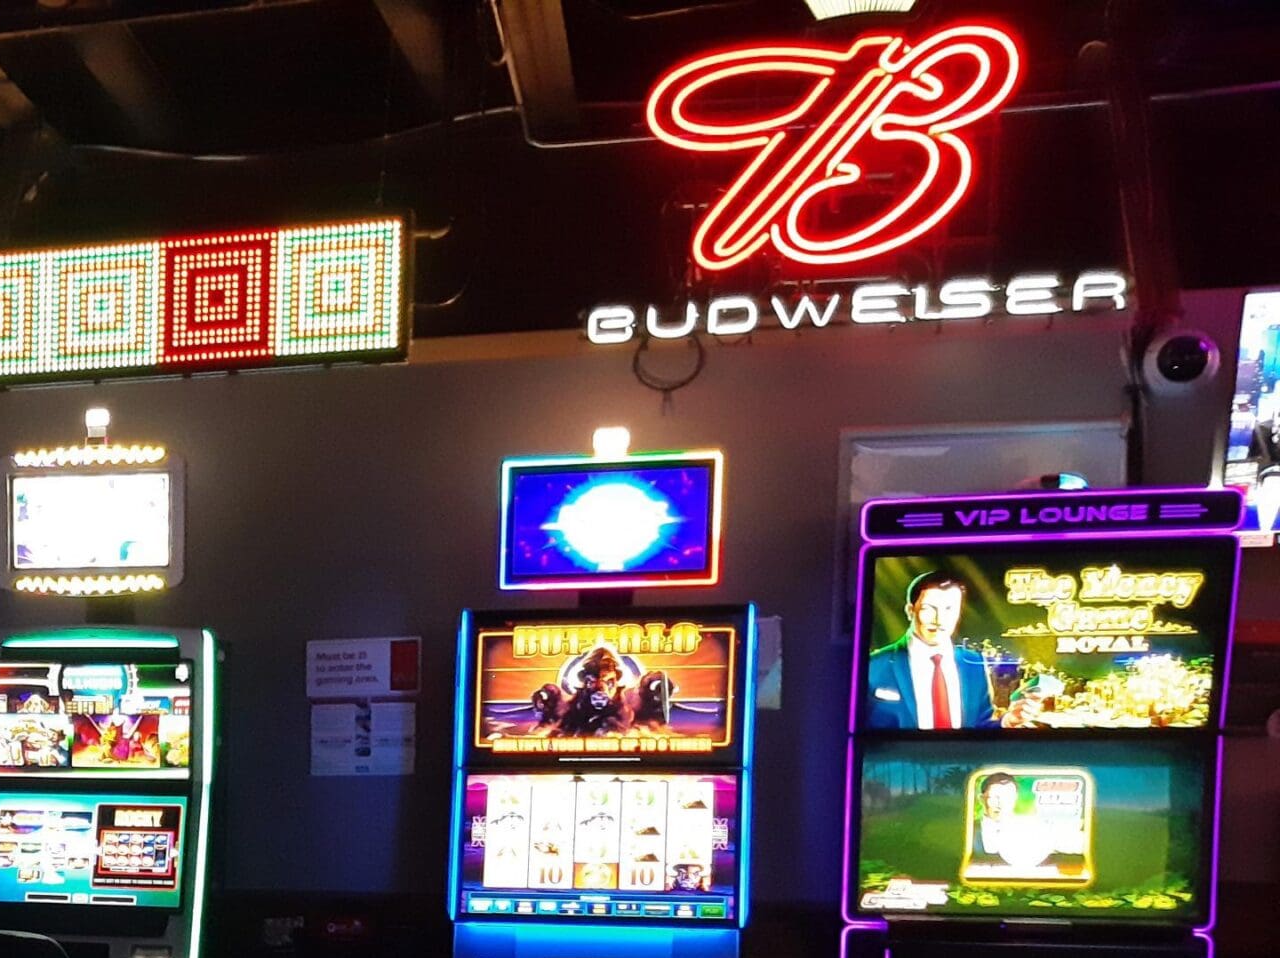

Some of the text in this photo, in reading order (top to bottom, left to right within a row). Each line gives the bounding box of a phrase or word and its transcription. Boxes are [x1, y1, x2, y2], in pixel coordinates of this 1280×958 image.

[586, 270, 1128, 345] BUDWEISER
[954, 504, 1149, 526] VIP LOUNGE
[1006, 569, 1076, 604] The
[1048, 602, 1154, 634] Game
[315, 652, 340, 661] Must
[342, 651, 356, 661] be
[328, 664, 354, 673] enter
[355, 663, 373, 672] the
[538, 867, 655, 886] 10 10
